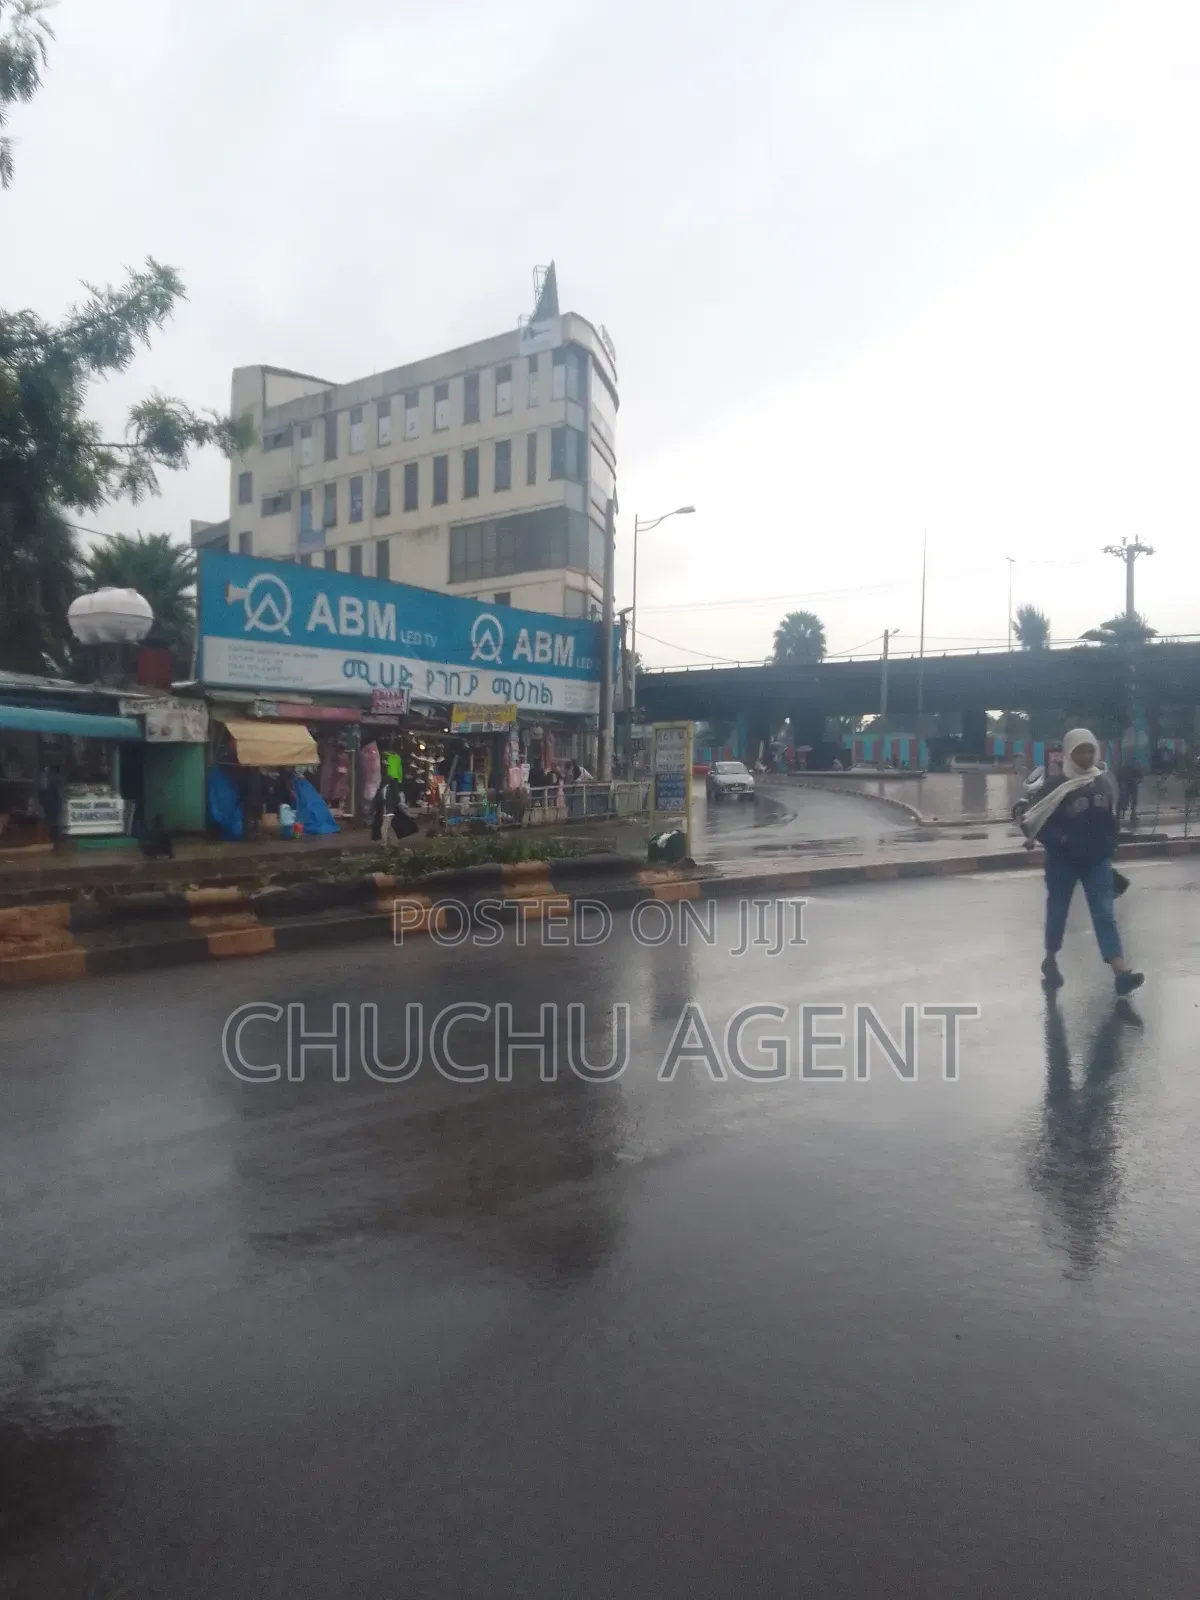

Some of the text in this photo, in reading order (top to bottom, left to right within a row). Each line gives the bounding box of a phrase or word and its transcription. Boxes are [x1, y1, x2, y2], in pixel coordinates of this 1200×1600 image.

[306, 592, 438, 648] ABM LED TV
[511, 627, 575, 668] ABM
[426, 668, 480, 697] የገበያ
